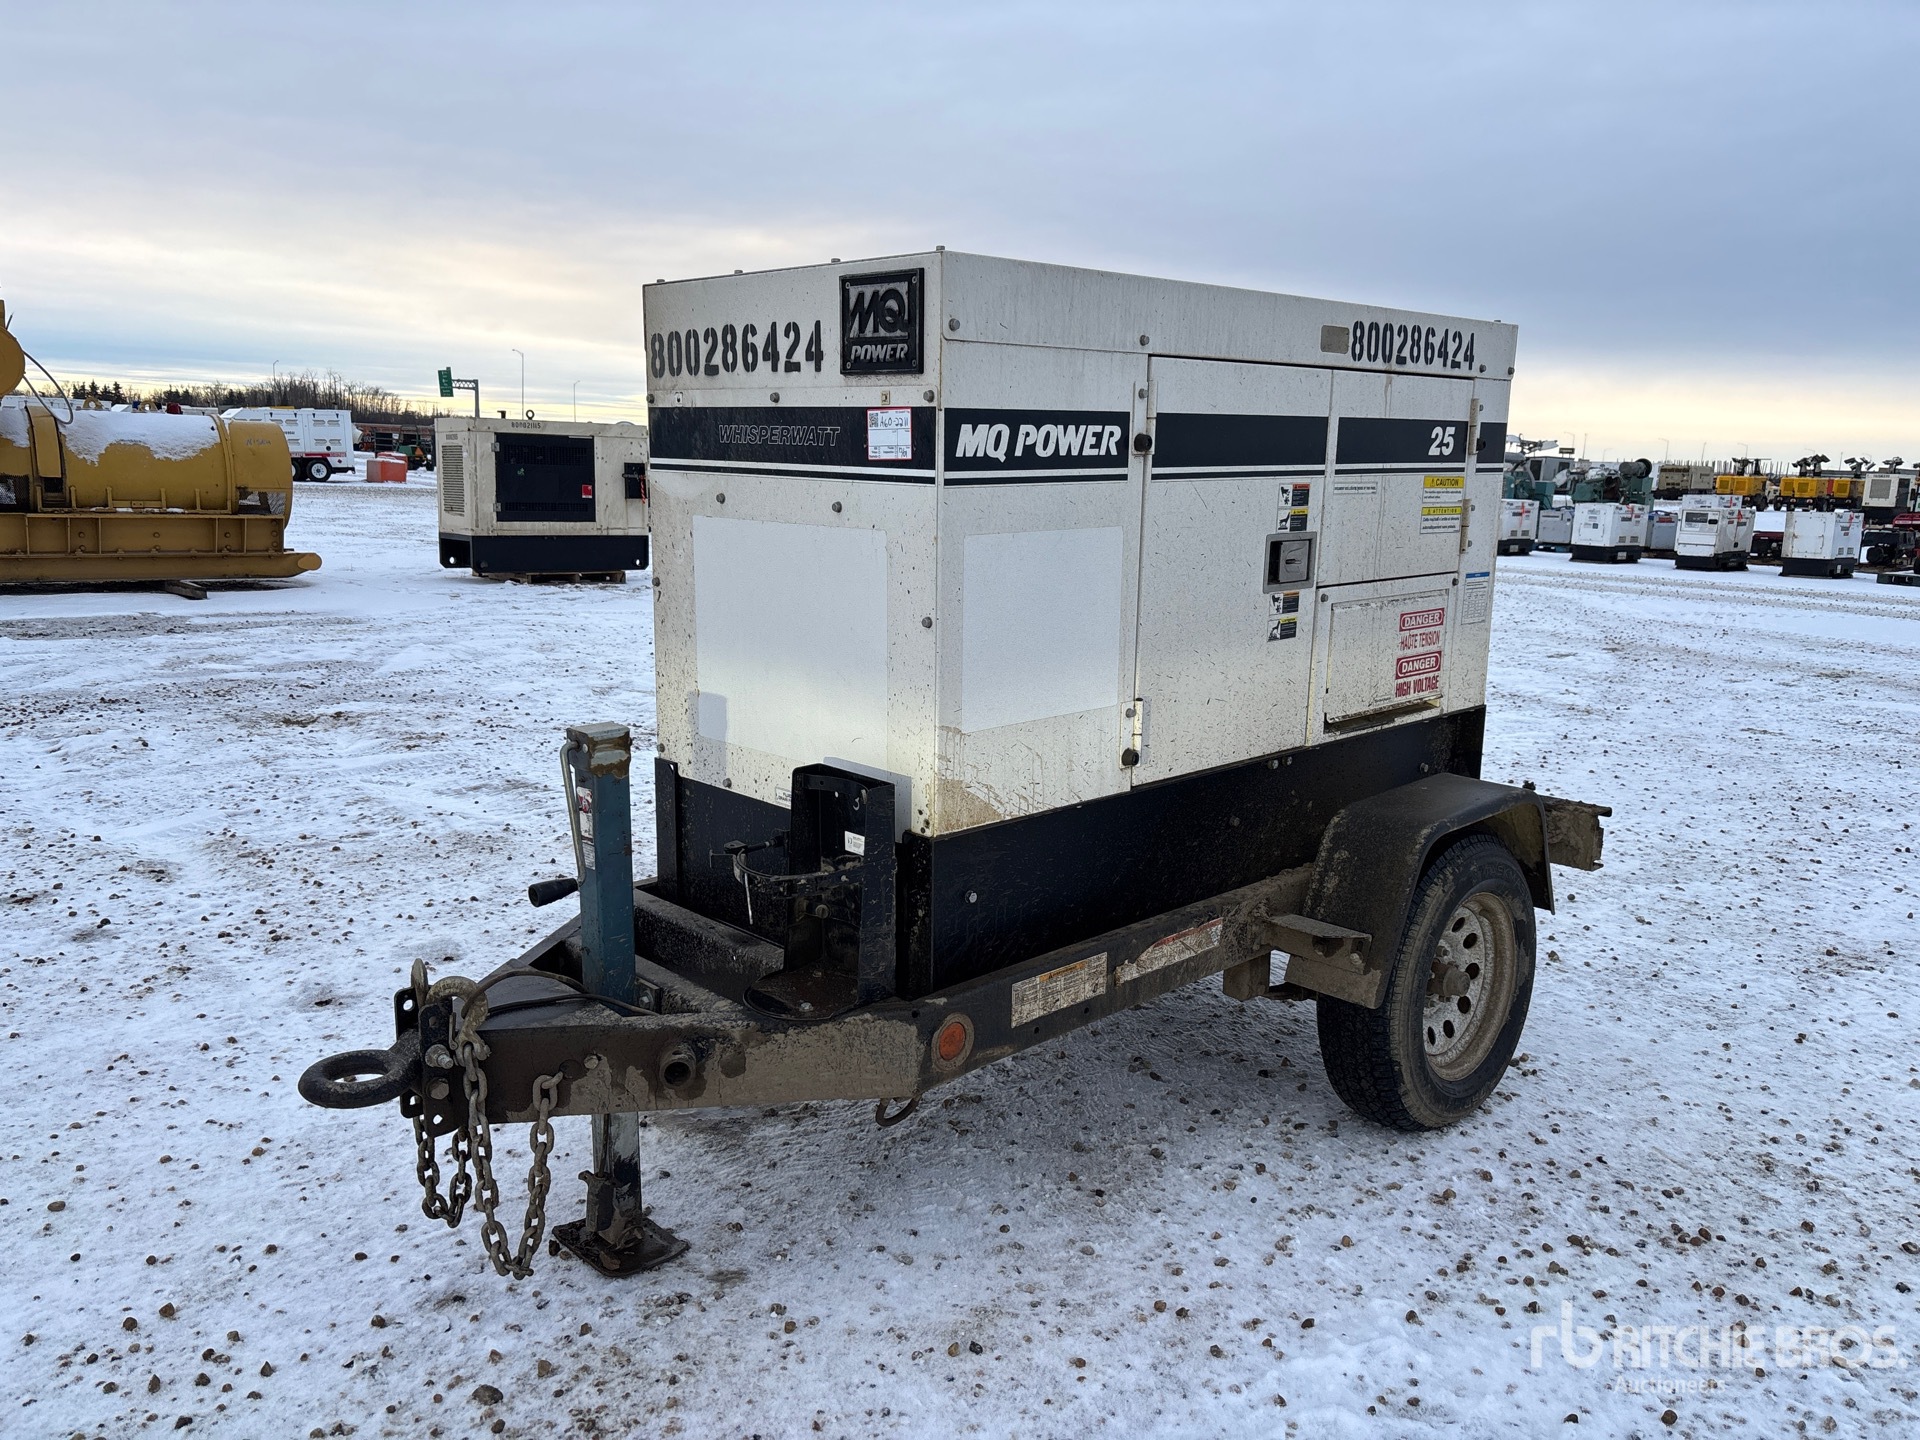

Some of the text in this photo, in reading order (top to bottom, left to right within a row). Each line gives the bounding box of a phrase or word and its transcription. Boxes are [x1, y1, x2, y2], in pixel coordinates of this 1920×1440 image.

[850, 288, 909, 333] MQ
[650, 320, 824, 379] 800286424
[851, 344, 908, 363] POWER
[1351, 320, 1475, 371] 800286424
[719, 425, 840, 447] WHISPERWATT
[955, 423, 1122, 463] MQ POWER
[1427, 426, 1456, 456] 25
[1435, 478, 1459, 487] CAUTION
[1404, 613, 1440, 627] DANGER
[1400, 630, 1441, 651] HAUTE TENSION
[1401, 657, 1436, 673] DANGER
[1395, 675, 1440, 698] HIGH VOLTAGE
